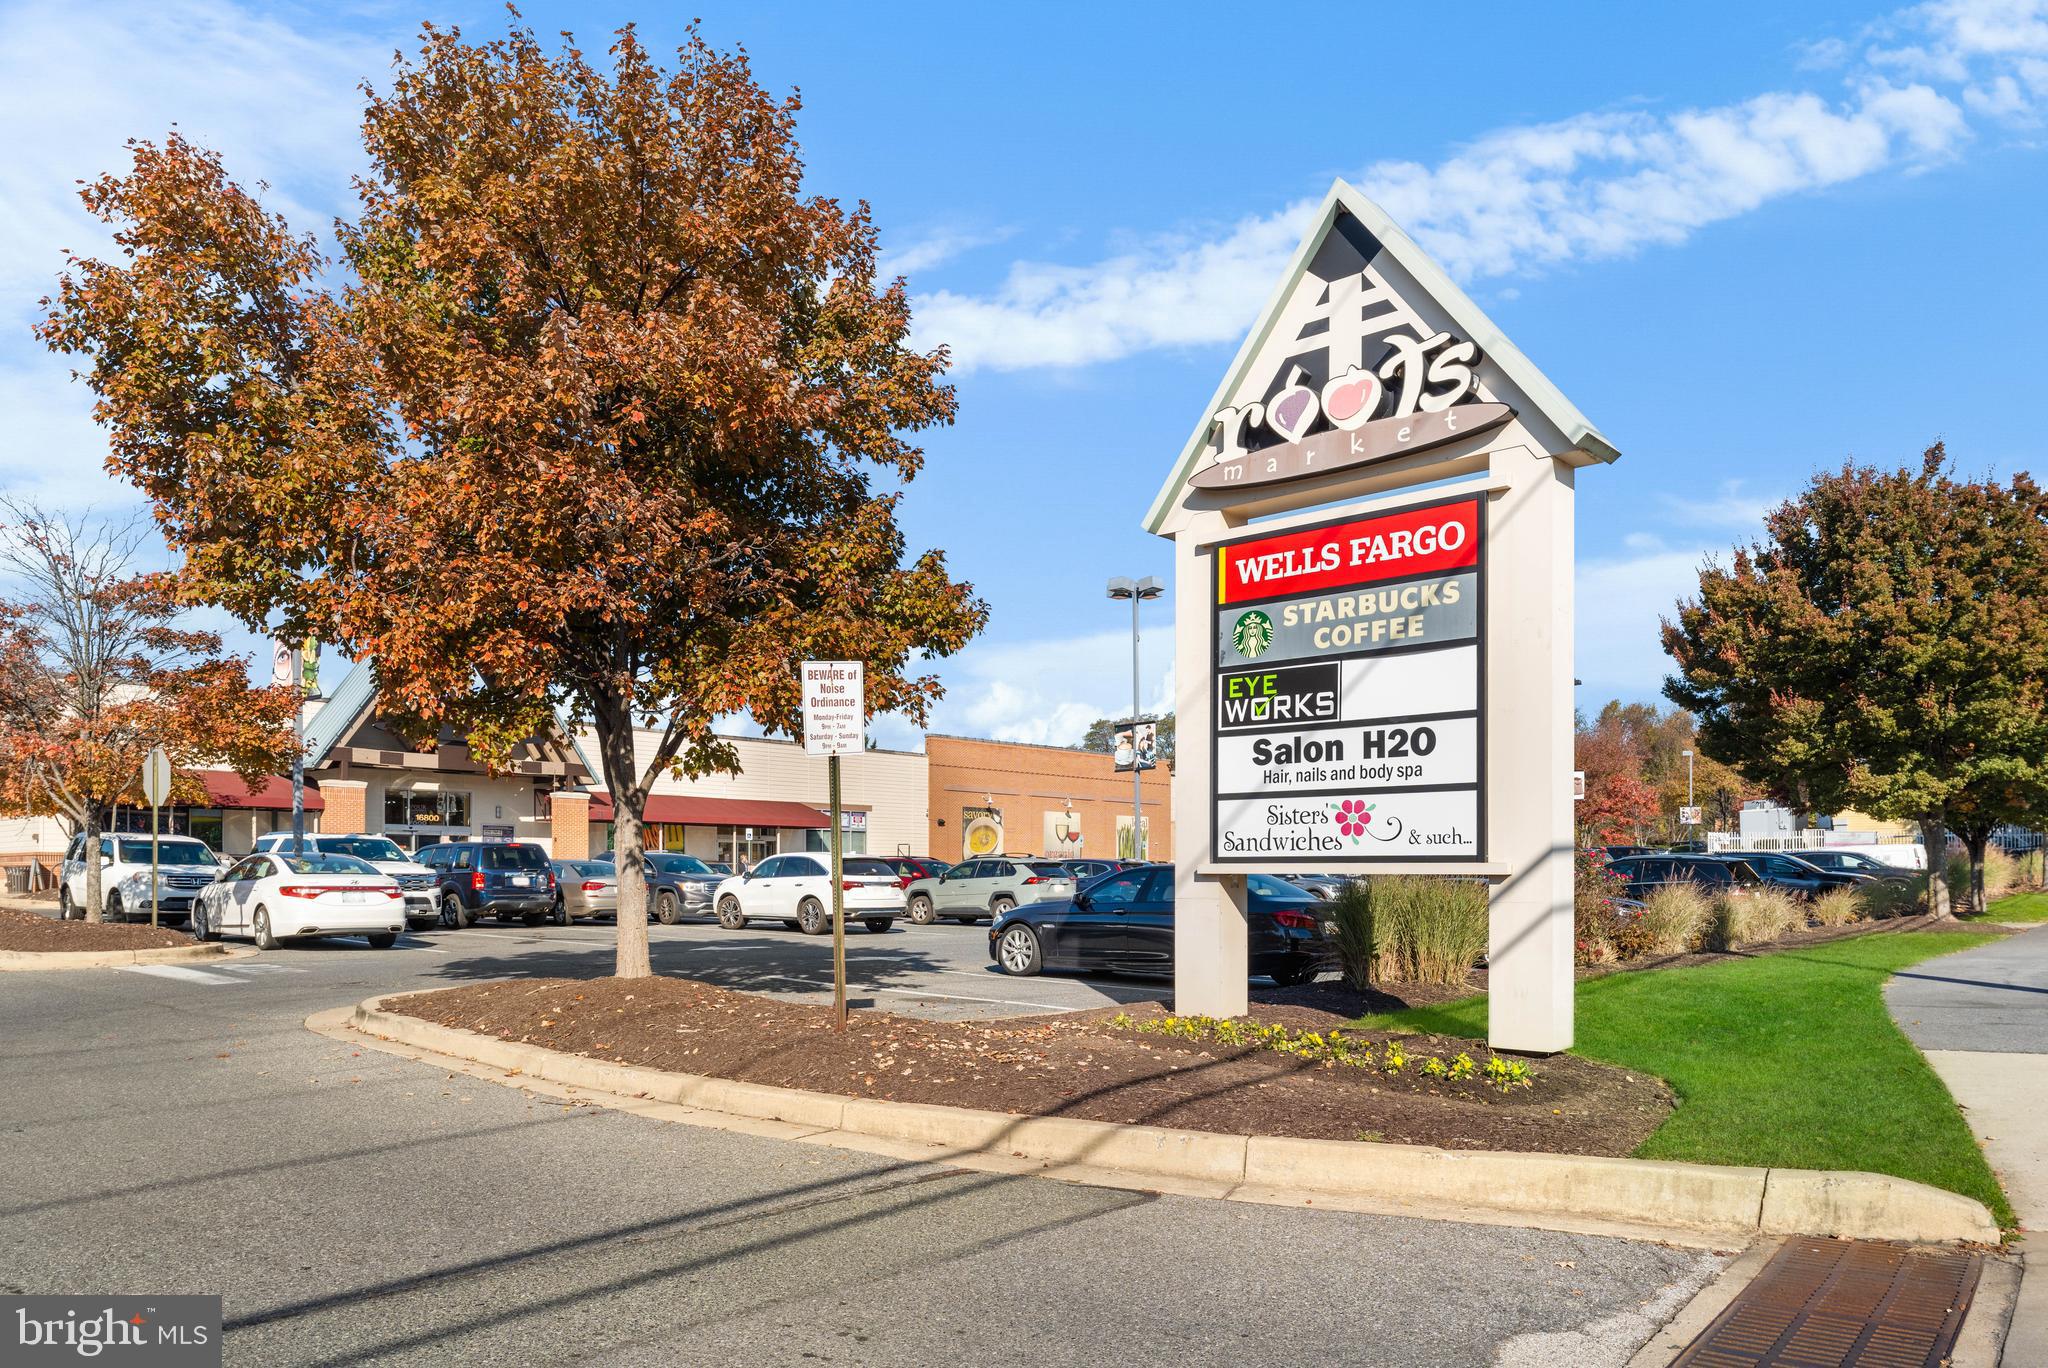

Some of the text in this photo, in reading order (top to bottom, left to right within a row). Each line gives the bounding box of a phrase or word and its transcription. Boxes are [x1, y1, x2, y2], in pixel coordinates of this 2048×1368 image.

[1213, 331, 1477, 464] roots
[1224, 410, 1457, 481] market
[1236, 521, 1466, 584] WELLS FARGO
[1283, 581, 1460, 627] STARBUCKS
[1313, 615, 1424, 649] COFFEE
[808, 670, 857, 680] BEWARE of
[1229, 674, 1278, 698] EYE
[820, 683, 845, 693] Noise
[811, 697, 855, 707] Ordinance
[1225, 691, 1334, 723] WORKS
[814, 713, 854, 721] Monday-Friday
[810, 733, 833, 741] Saturday
[839, 732, 859, 740] Sunday
[1252, 736, 1344, 766] Salon
[1263, 764, 1423, 785] Hair, nails and body spa
[416, 814, 440, 822] 16800
[964, 811, 992, 820] savory
[1267, 803, 1329, 826] Sisters'
[1223, 826, 1473, 852] Sandwiches & such...
